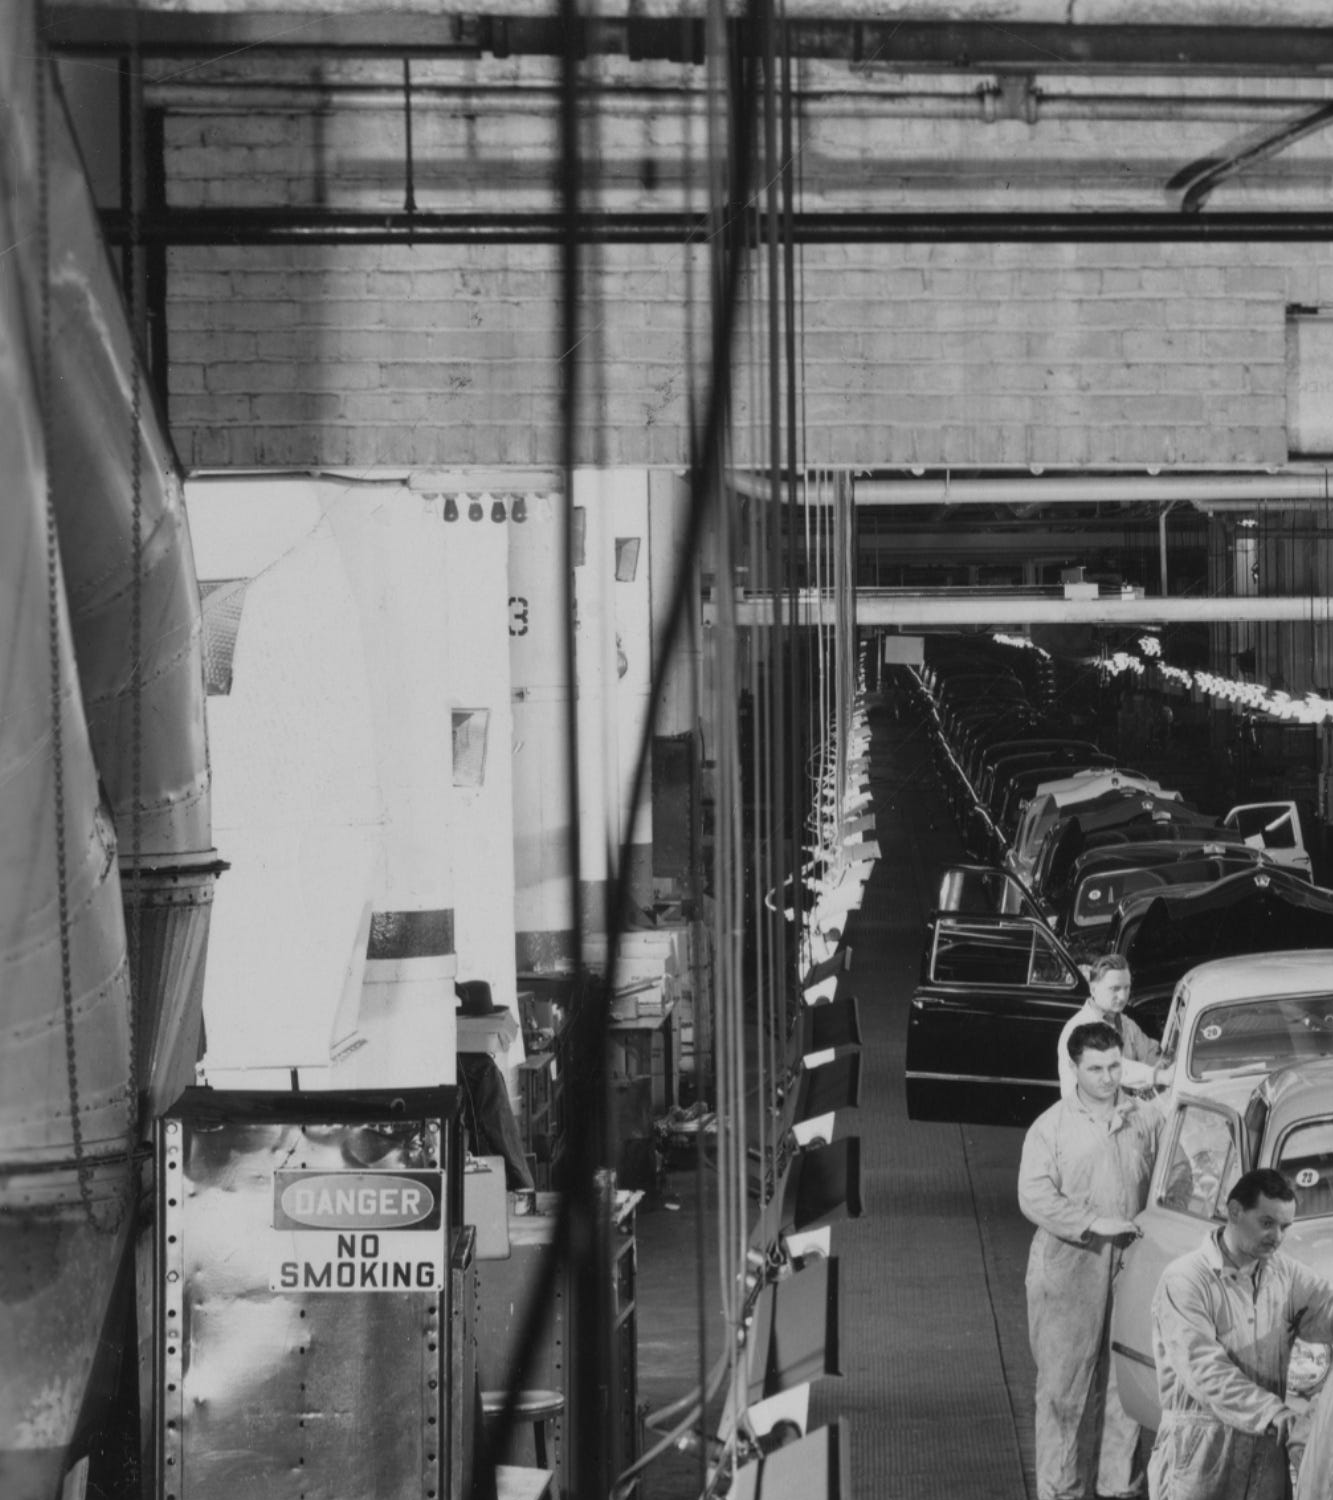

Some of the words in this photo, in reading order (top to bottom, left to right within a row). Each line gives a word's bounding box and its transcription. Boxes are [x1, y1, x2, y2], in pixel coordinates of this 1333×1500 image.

[508, 596, 528, 636] 3
[295, 1188, 420, 1216] DANGER
[338, 1234, 380, 1258] NO
[281, 1261, 434, 1288] SMOKING
